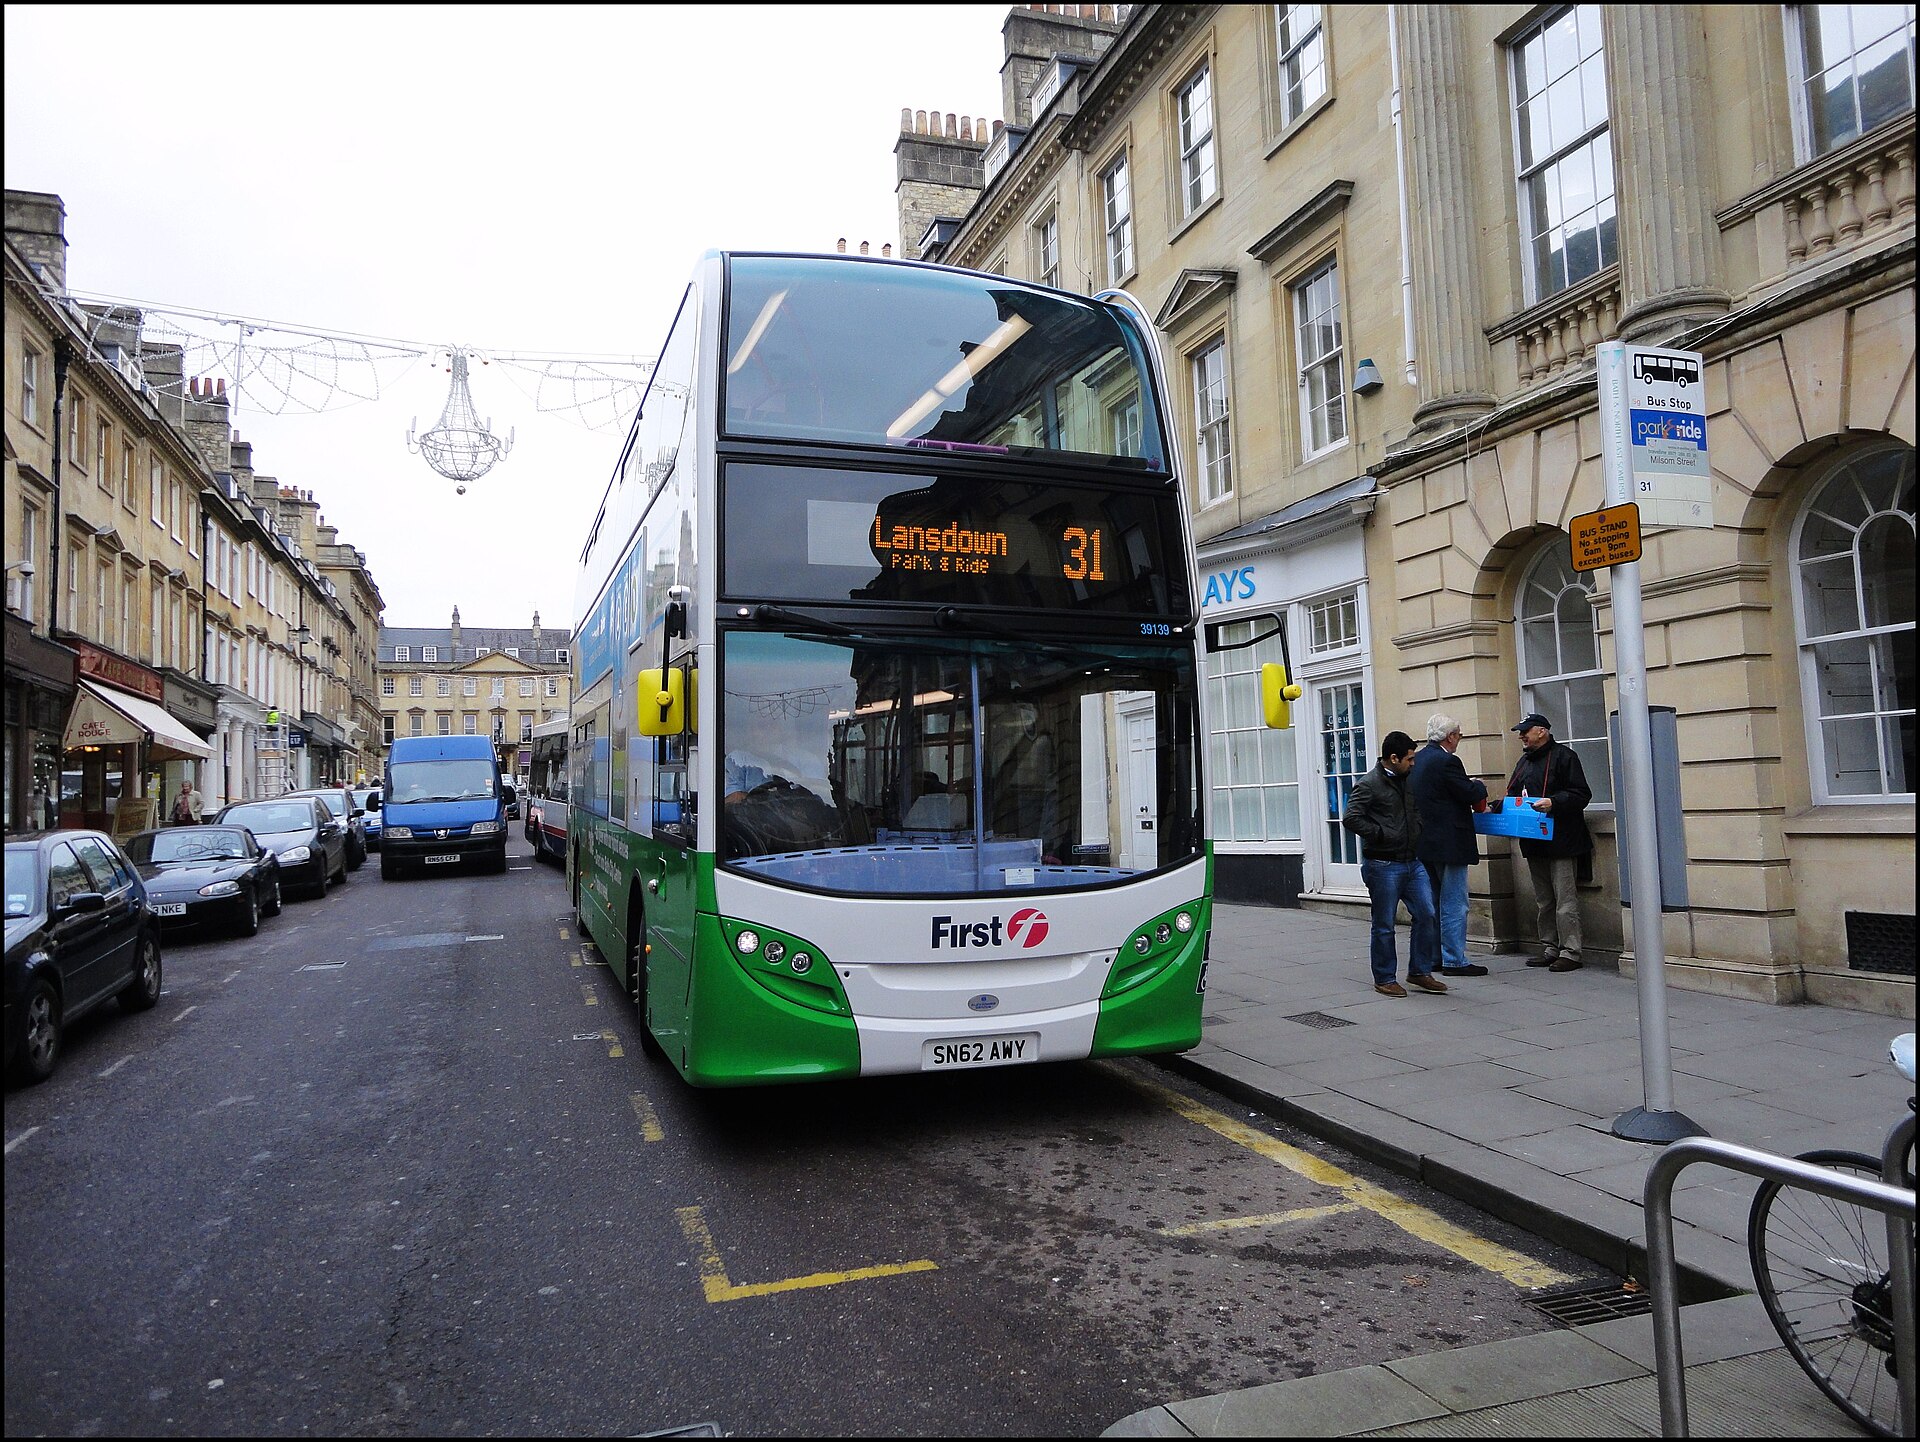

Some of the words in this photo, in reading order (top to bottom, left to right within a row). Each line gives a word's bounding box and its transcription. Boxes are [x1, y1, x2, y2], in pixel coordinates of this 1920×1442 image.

[1647, 395, 1667, 407] Bus
[1669, 397, 1692, 411] Stop
[1637, 416, 1669, 440] park
[1676, 419, 1702, 440] ride
[1650, 455, 1675, 465] Milsom
[1676, 457, 1696, 467] Street
[1640, 481, 1652, 492] 31
[1579, 527, 1597, 539] BUS
[1599, 520, 1628, 534] STAND
[875, 515, 1007, 556] Lansdown
[1063, 526, 1105, 582] 31
[1579, 540, 1590, 549] No
[1593, 531, 1630, 545] stopping
[1583, 547, 1602, 557] 6am
[1607, 541, 1627, 551] 9pm
[892, 553, 933, 571] Park
[955, 557, 990, 574] Ride
[1578, 554, 1606, 567] except
[1608, 549, 1635, 560] buses
[1140, 623, 1170, 636] 39139
[77, 728, 111, 738] ROUGE
[81, 721, 106, 731] CAFE
[161, 904, 182, 914] NKE
[931, 916, 1002, 949] First
[933, 1043, 984, 1064] SN62
[989, 1039, 1026, 1060] AWY
